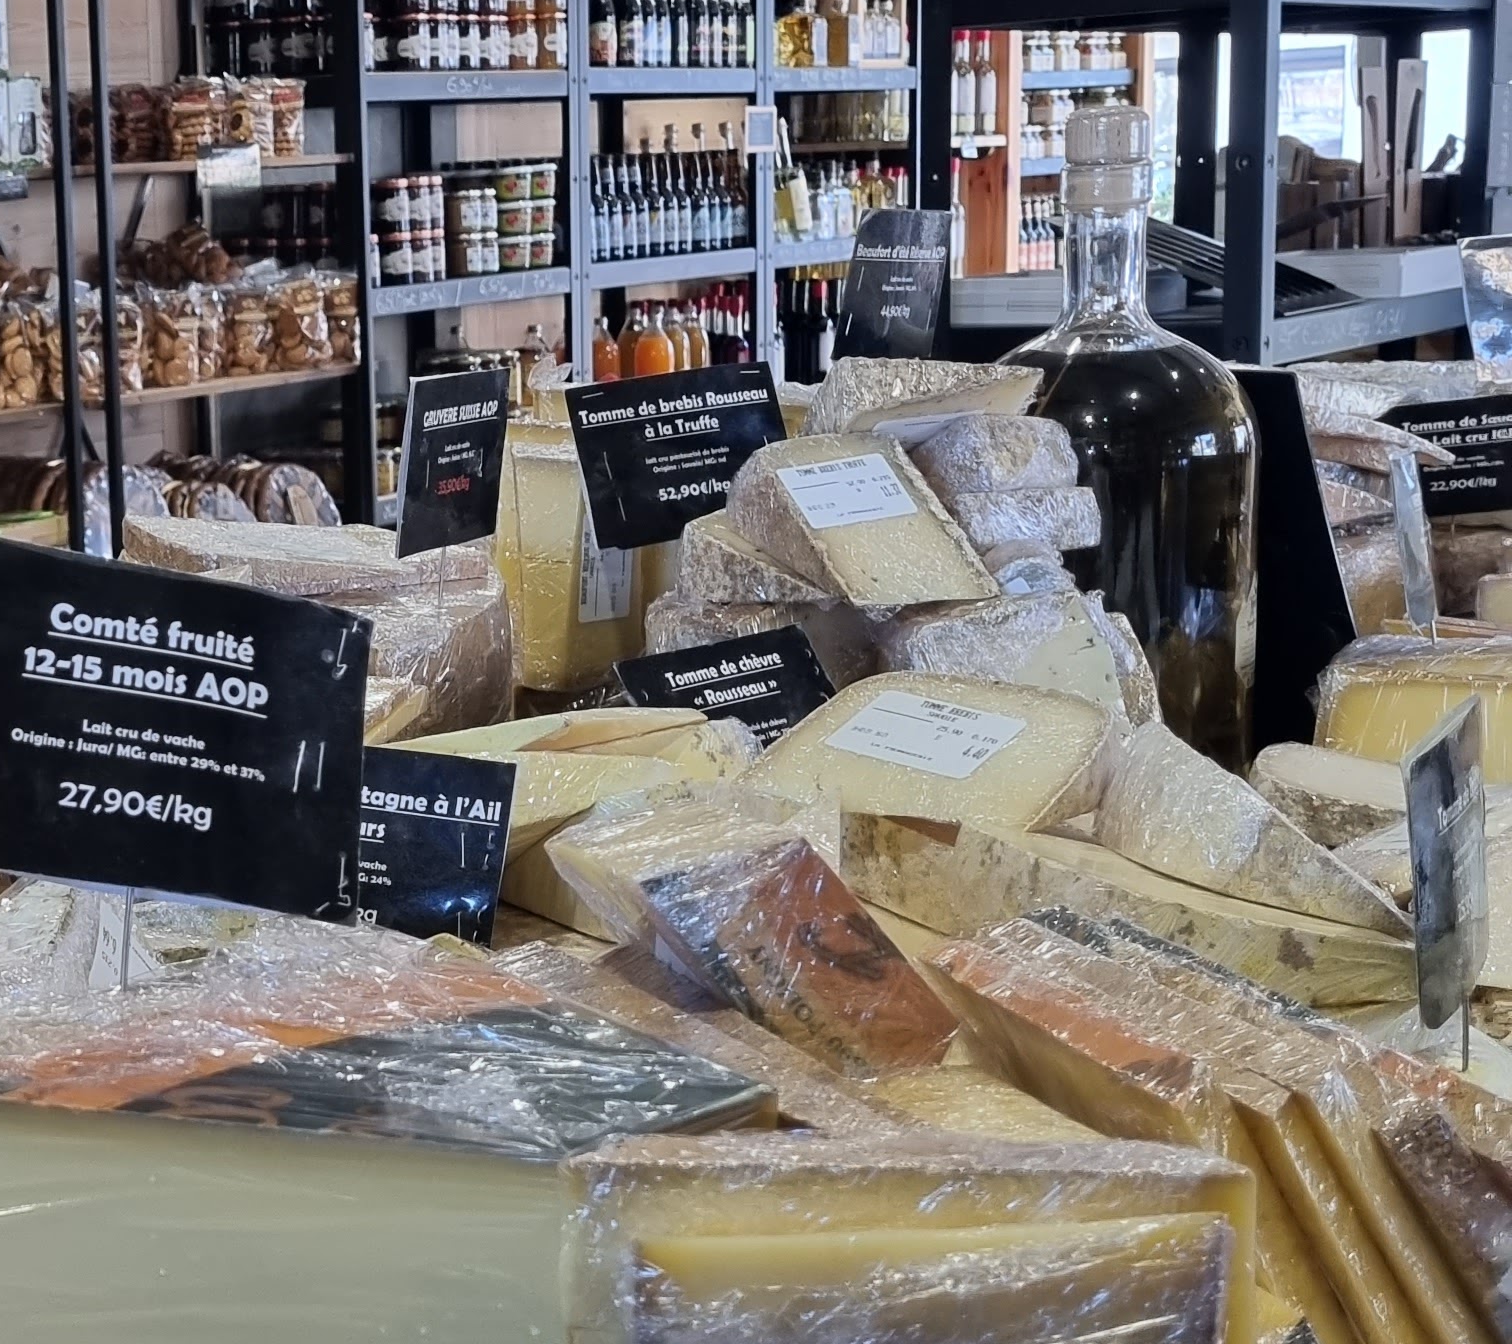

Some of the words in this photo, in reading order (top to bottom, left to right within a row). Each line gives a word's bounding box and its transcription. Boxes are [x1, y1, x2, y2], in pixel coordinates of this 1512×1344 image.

[857, 243, 891, 258] Beaufort
[481, 399, 498, 417] AOP
[578, 406, 635, 425] Tomme
[638, 400, 657, 416] de
[659, 395, 704, 412] brebis
[705, 387, 768, 407] Rousseau
[644, 424, 655, 439] à
[659, 422, 673, 436] la
[675, 414, 720, 434] Truffe
[1401, 419, 1455, 433] Tomme
[1458, 416, 1477, 428] de
[711, 445, 730, 455] brebis
[1432, 433, 1462, 446] Lait
[1465, 433, 1490, 443] cru
[653, 463, 677, 474] Origine
[659, 478, 730, 502] 52,90€/kg
[50, 602, 159, 645] Comté
[167, 620, 255, 664] fruité
[24, 646, 103, 682] 12-15
[111, 665, 188, 695] mois
[195, 671, 270, 710] AOP
[665, 666, 719, 689] Tomme
[720, 659, 738, 675] de
[738, 652, 782, 672] chèvre
[704, 682, 768, 706] Rousseau
[82, 719, 112, 736] Lait
[115, 726, 138, 740] cru
[141, 728, 161, 743] de
[162, 732, 206, 750] vache
[11, 727, 66, 749] Origine
[76, 737, 113, 756] Jura/
[116, 743, 147, 761] MG:
[149, 752, 188, 767] entre
[190, 756, 221, 773] 29%
[223, 762, 238, 777] et
[240, 766, 266, 783] 37%
[58, 781, 213, 832] 27,90€/kg
[433, 793, 449, 815] à
[454, 796, 502, 822] l'Ail
[358, 860, 388, 872] vache
[369, 875, 392, 886] 24%
